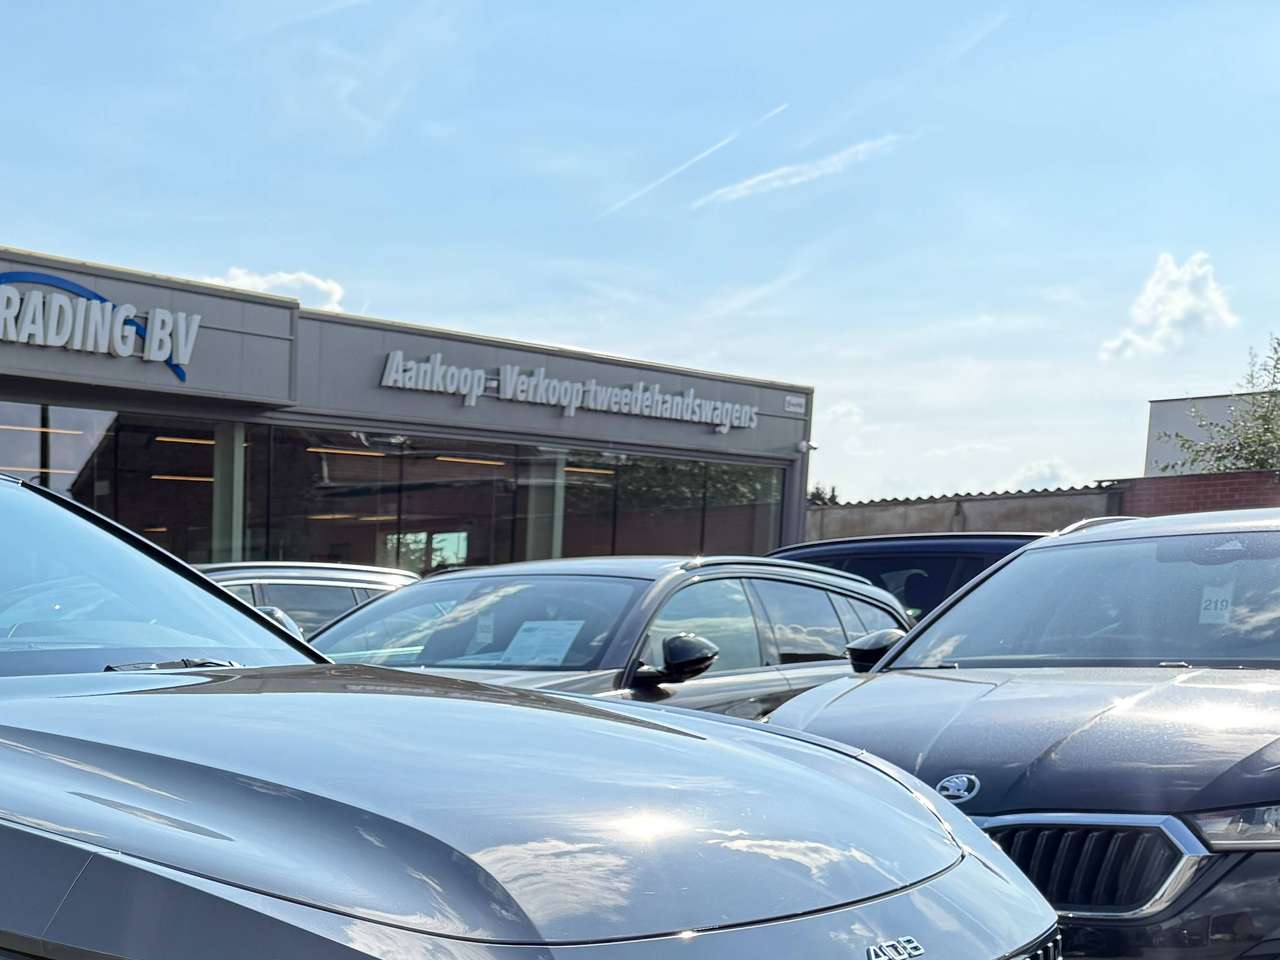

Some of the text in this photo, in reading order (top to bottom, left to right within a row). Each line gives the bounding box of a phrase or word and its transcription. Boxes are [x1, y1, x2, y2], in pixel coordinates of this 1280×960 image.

[144, 307, 201, 365] BV
[381, 350, 486, 407] Aankoop
[499, 364, 583, 418] Verkoop
[585, 379, 758, 433] tweedehandswagens
